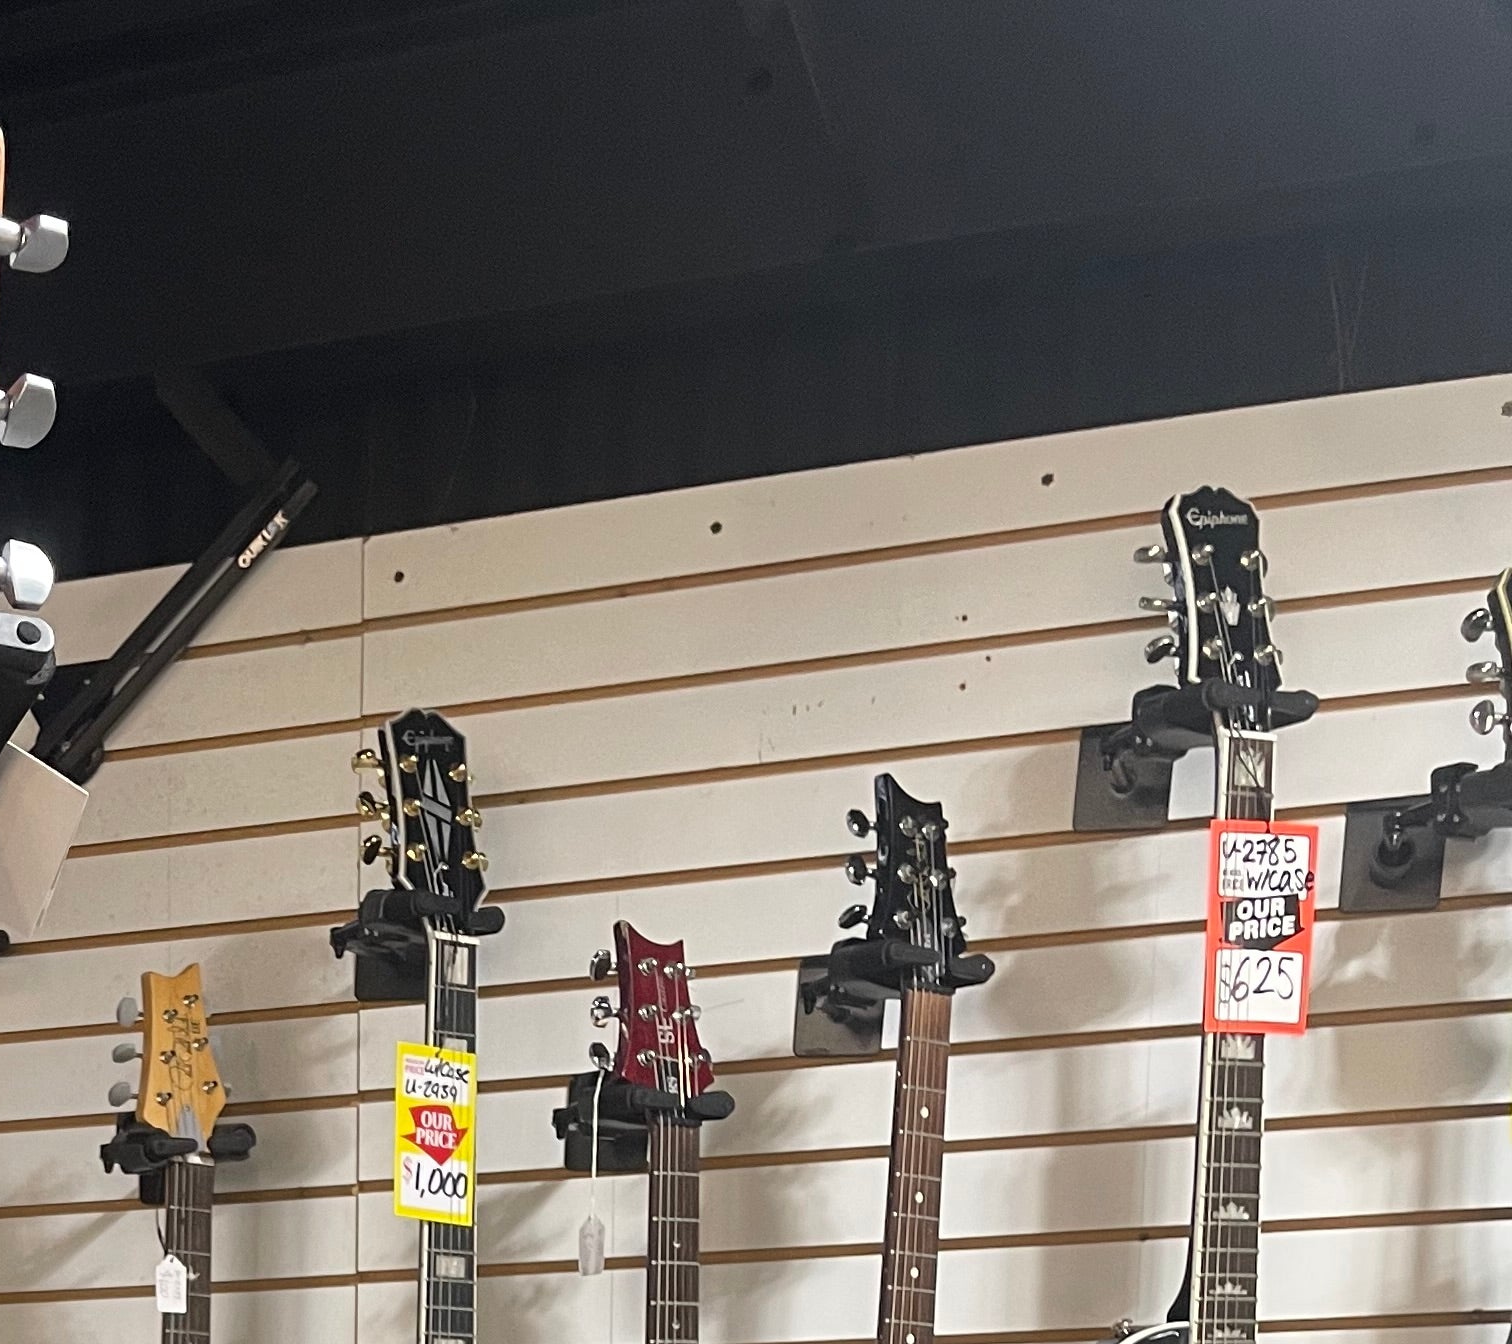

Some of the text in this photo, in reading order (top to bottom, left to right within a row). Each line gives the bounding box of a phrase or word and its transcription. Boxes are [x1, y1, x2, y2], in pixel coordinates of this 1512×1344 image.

[1236, 897, 1286, 921] OUR
[1228, 915, 1296, 941] PRICE
[420, 1110, 453, 1131] OUR
[415, 1127, 458, 1149] PRICE
